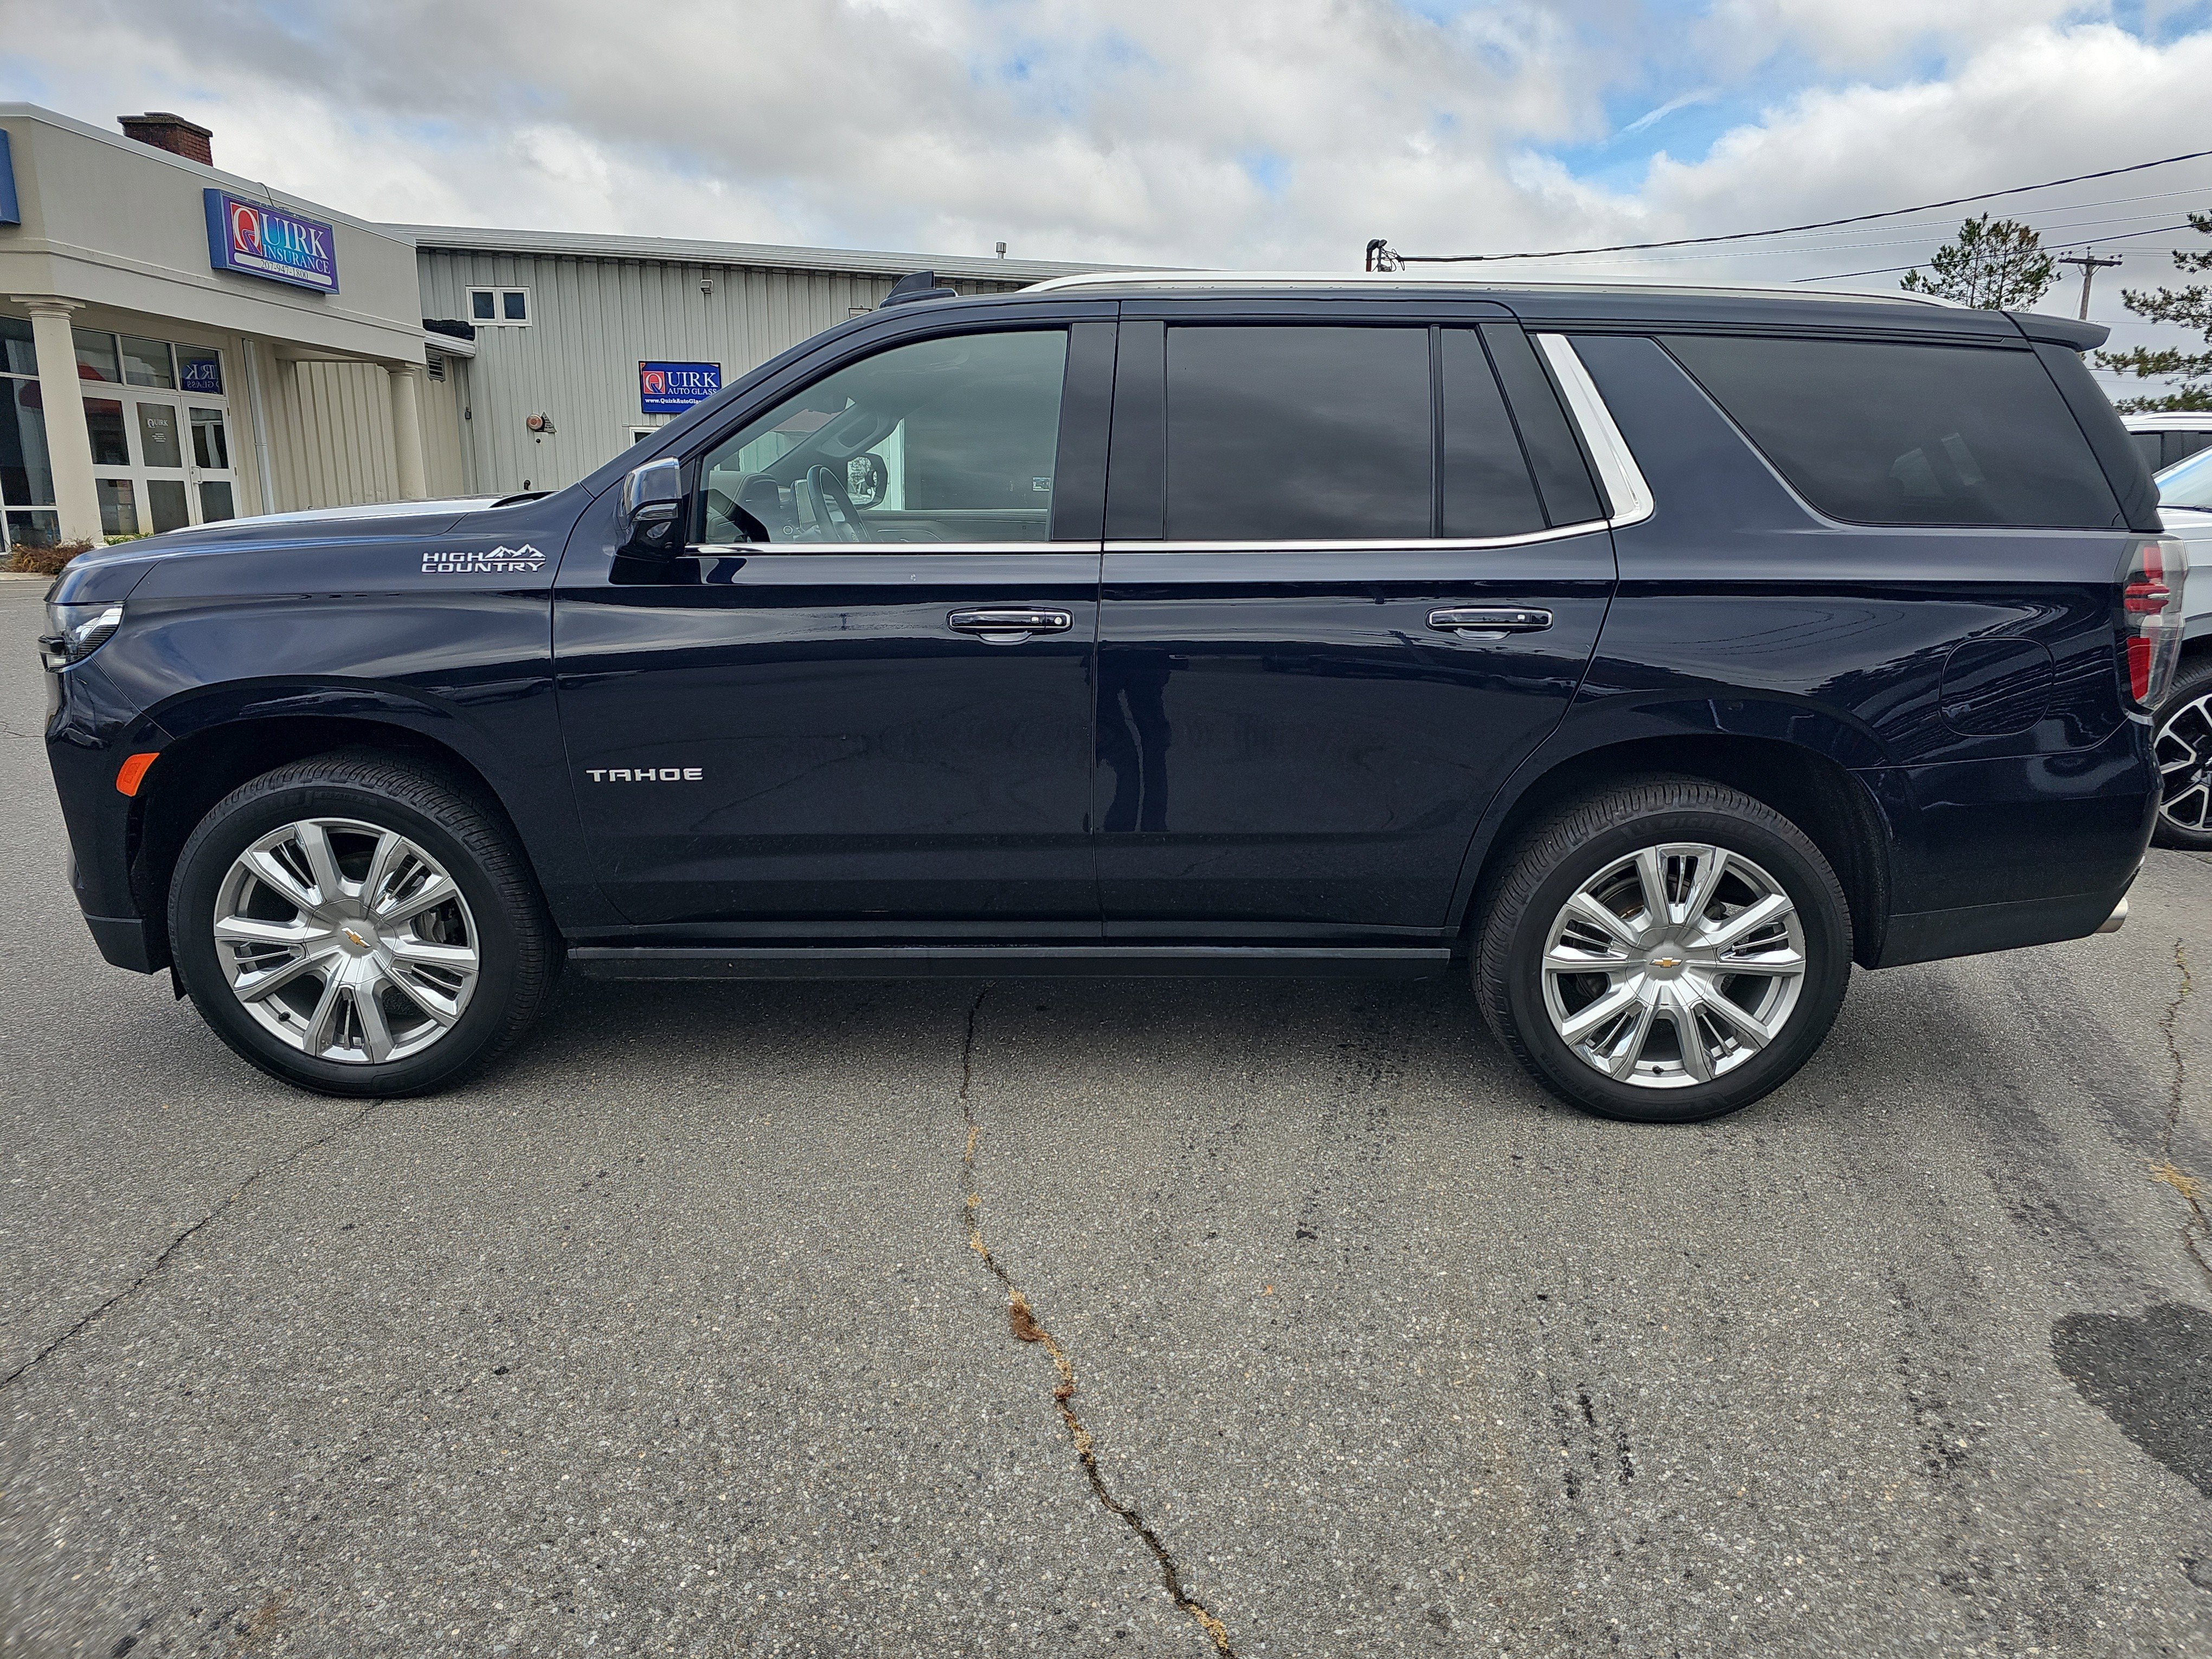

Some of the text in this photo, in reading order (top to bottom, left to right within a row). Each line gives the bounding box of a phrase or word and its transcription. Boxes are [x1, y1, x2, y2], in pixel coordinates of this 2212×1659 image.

[233, 207, 329, 260] QUIRK
[263, 244, 331, 274] INSURANCE
[260, 260, 308, 280] 207-947-1800
[645, 371, 718, 394] QUIRK
[147, 419, 169, 428] QUIRK
[422, 552, 483, 562] HIGH
[421, 562, 546, 574] COUNTRY
[586, 768, 703, 782] TAHOE
